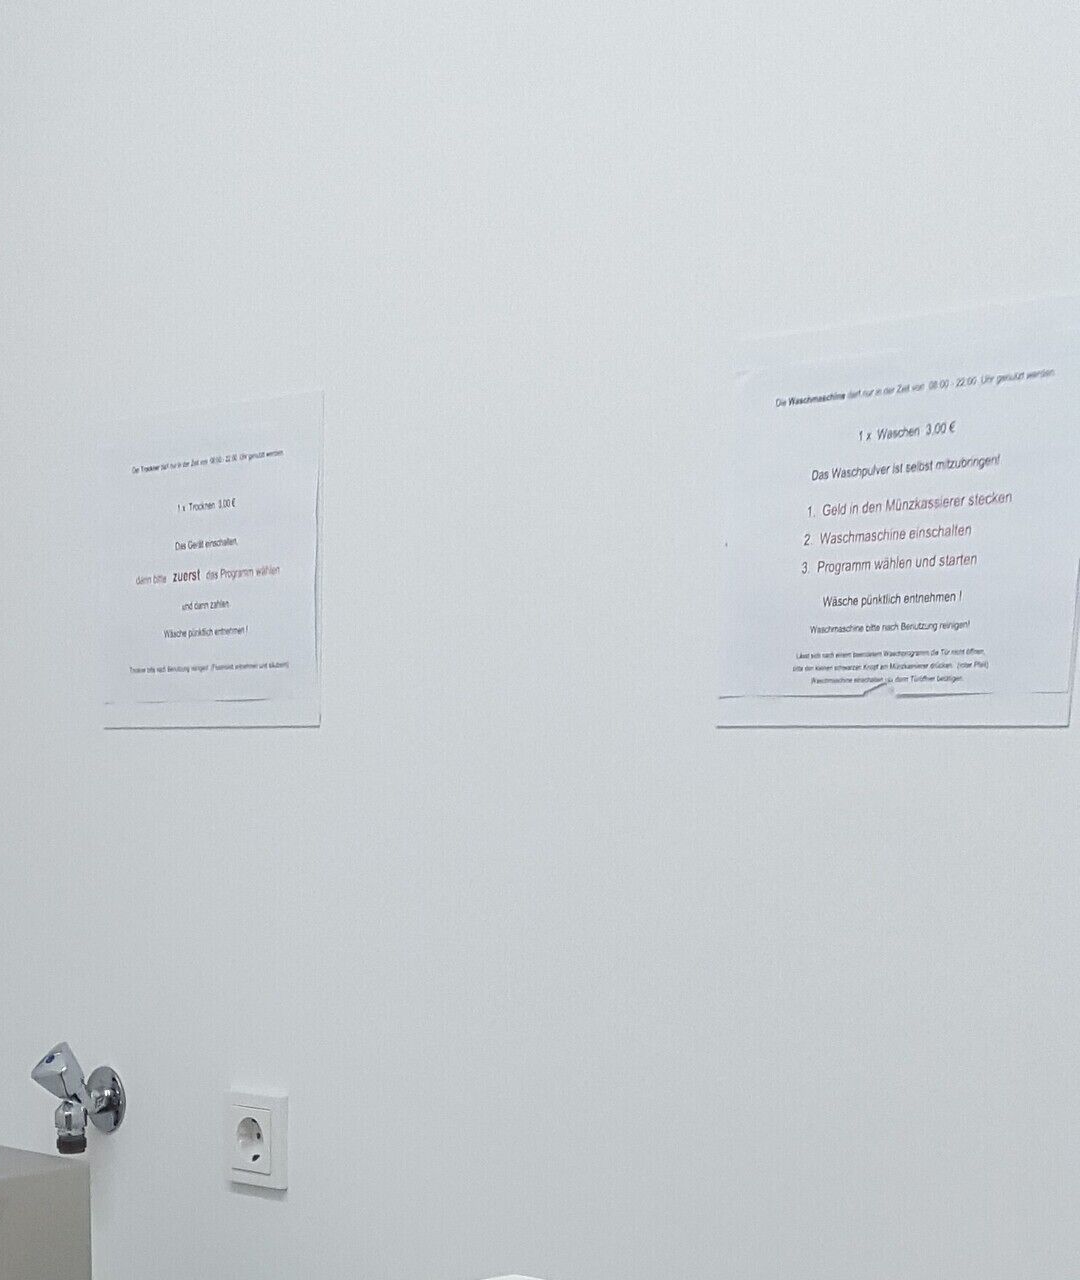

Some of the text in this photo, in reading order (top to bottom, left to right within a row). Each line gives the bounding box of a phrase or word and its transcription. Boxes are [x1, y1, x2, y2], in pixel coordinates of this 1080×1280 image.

[877, 425, 920, 441] Waschen
[948, 420, 956, 433] €
[811, 469, 829, 482] Das
[831, 463, 890, 480] Waschpulver
[892, 463, 903, 474] ist
[905, 460, 933, 473] selbst
[189, 502, 215, 512] Trocknen
[807, 491, 1012, 518] 1. Geld in den Münzkassierer stecken
[820, 527, 906, 545] Waschmaschine
[909, 523, 972, 540] einschalten
[817, 559, 871, 576] Programm
[874, 555, 912, 571] wählen
[915, 554, 936, 568] und
[939, 553, 977, 567] starten
[172, 568, 201, 584] zuerst
[206, 570, 218, 580] das
[220, 566, 254, 582] Programm
[822, 595, 859, 608] Wäsche
[861, 593, 901, 608] pünktlich
[903, 591, 957, 605] entnehmen
[163, 629, 187, 639] Wäsche
[810, 622, 864, 634] Waschmaschine
[900, 621, 938, 633] Benutzung
